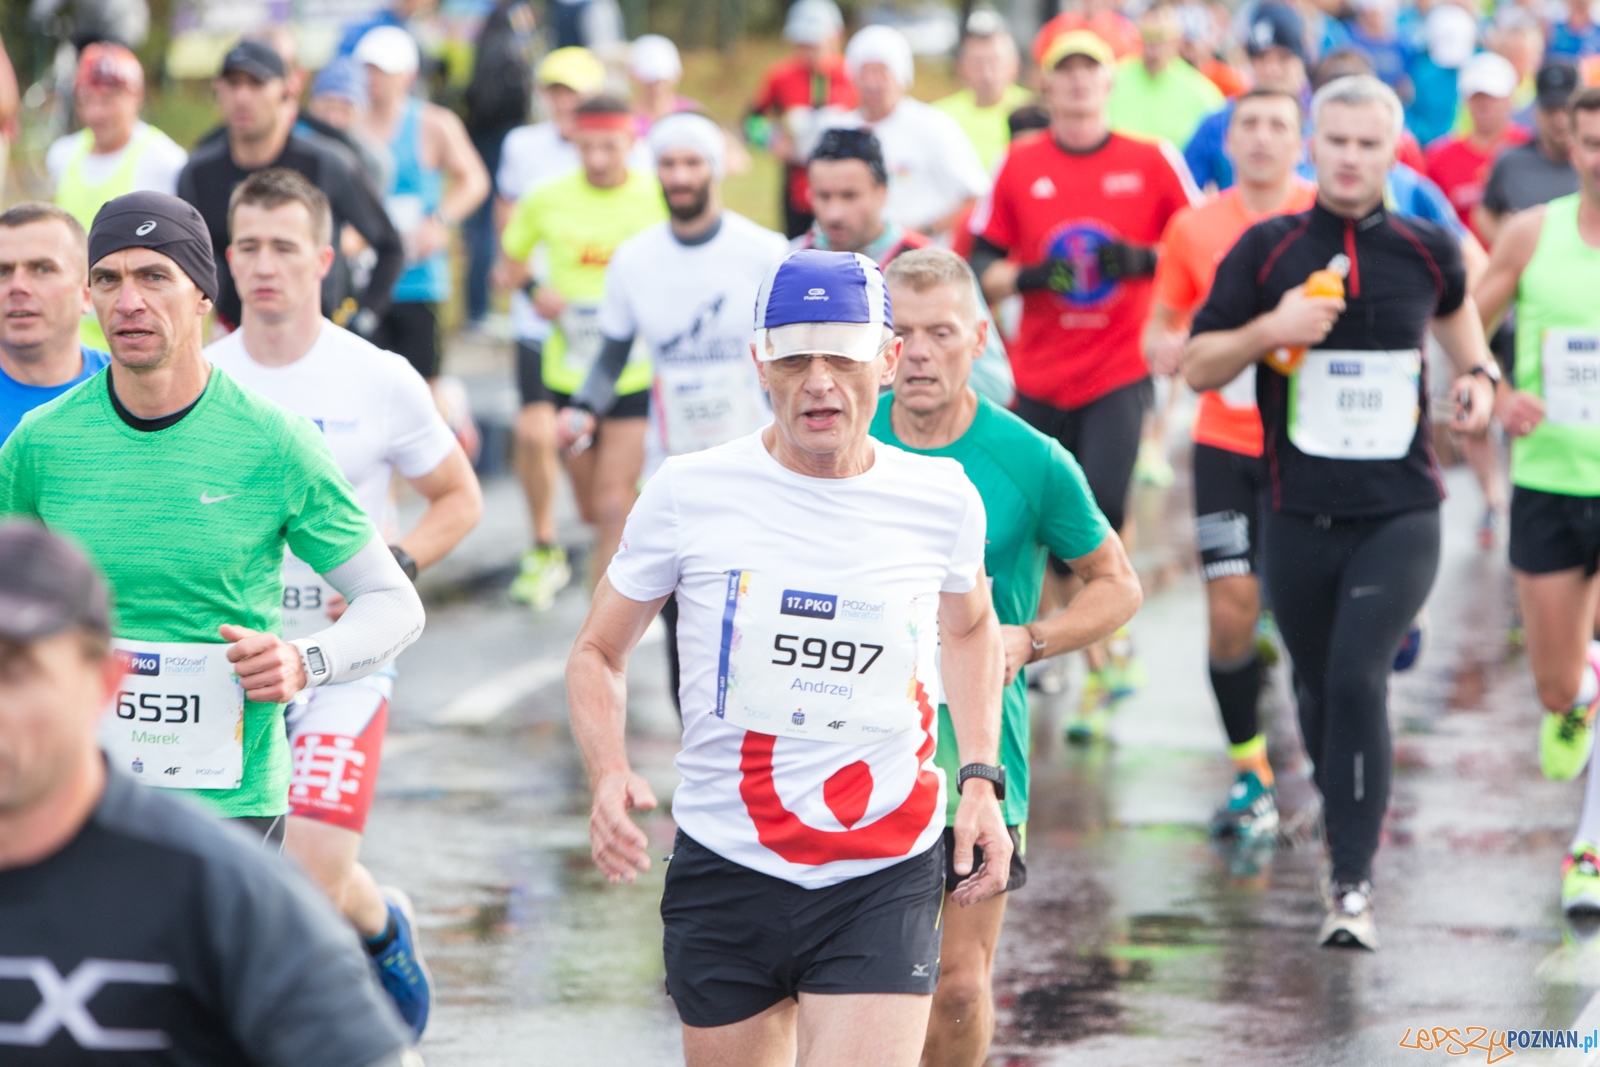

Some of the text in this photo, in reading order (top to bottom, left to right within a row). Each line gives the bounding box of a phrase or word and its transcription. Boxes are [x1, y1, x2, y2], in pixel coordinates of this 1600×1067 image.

[841, 609, 885, 620] maraton
[771, 633, 884, 675] 5997
[164, 664, 206, 674] maraton
[790, 677, 854, 700] Andrzej
[116, 690, 201, 723] 6531
[131, 730, 181, 745] Marek
